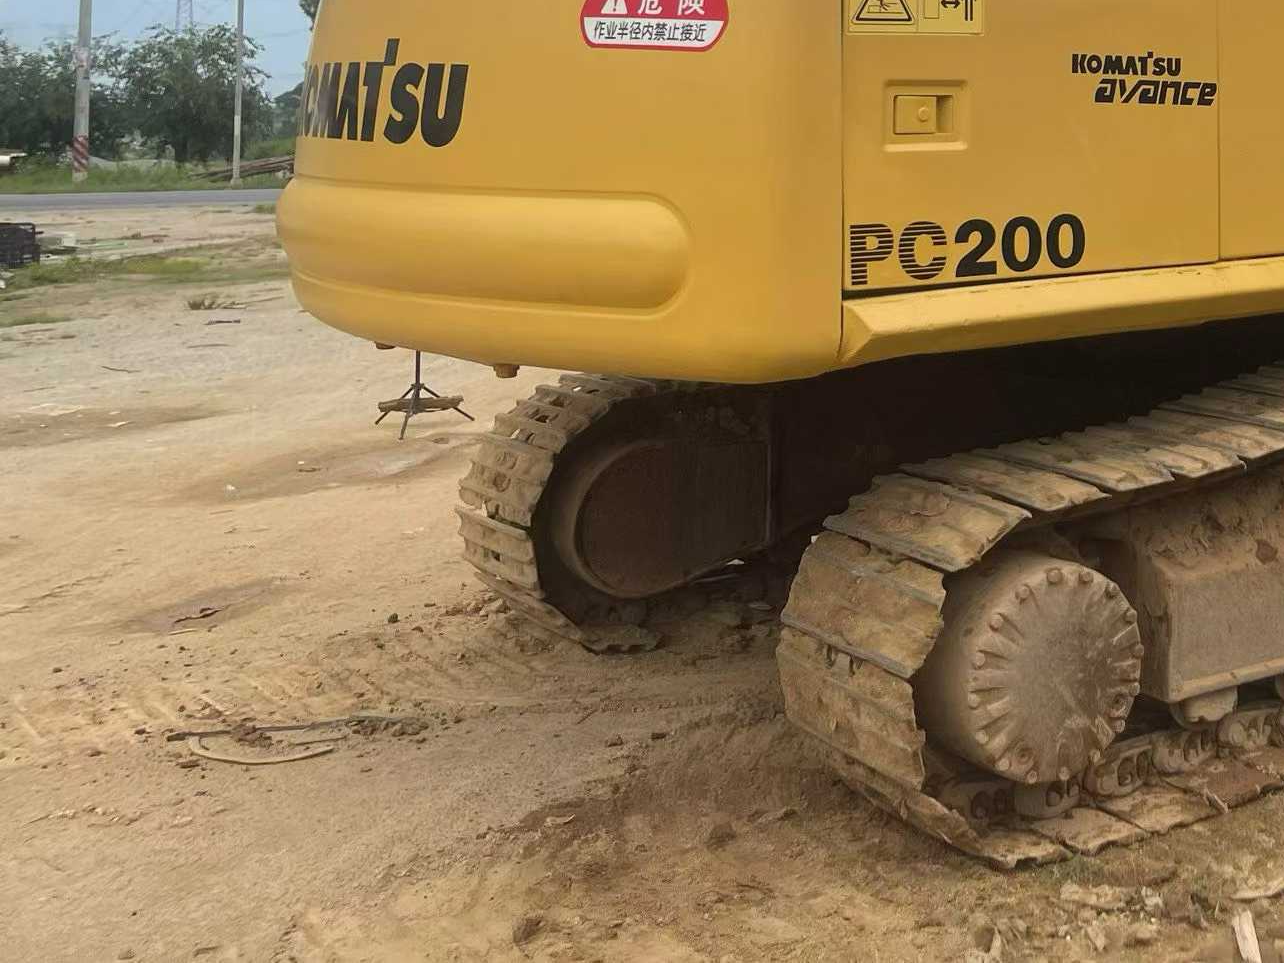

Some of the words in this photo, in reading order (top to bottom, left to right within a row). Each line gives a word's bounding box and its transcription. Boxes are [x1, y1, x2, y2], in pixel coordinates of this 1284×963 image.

[594, 21, 707, 41] 作业半径内禁止接近
[1072, 51, 1181, 76] KOMATSU
[1094, 78, 1217, 106] avance
[849, 214, 1085, 285] PC200
